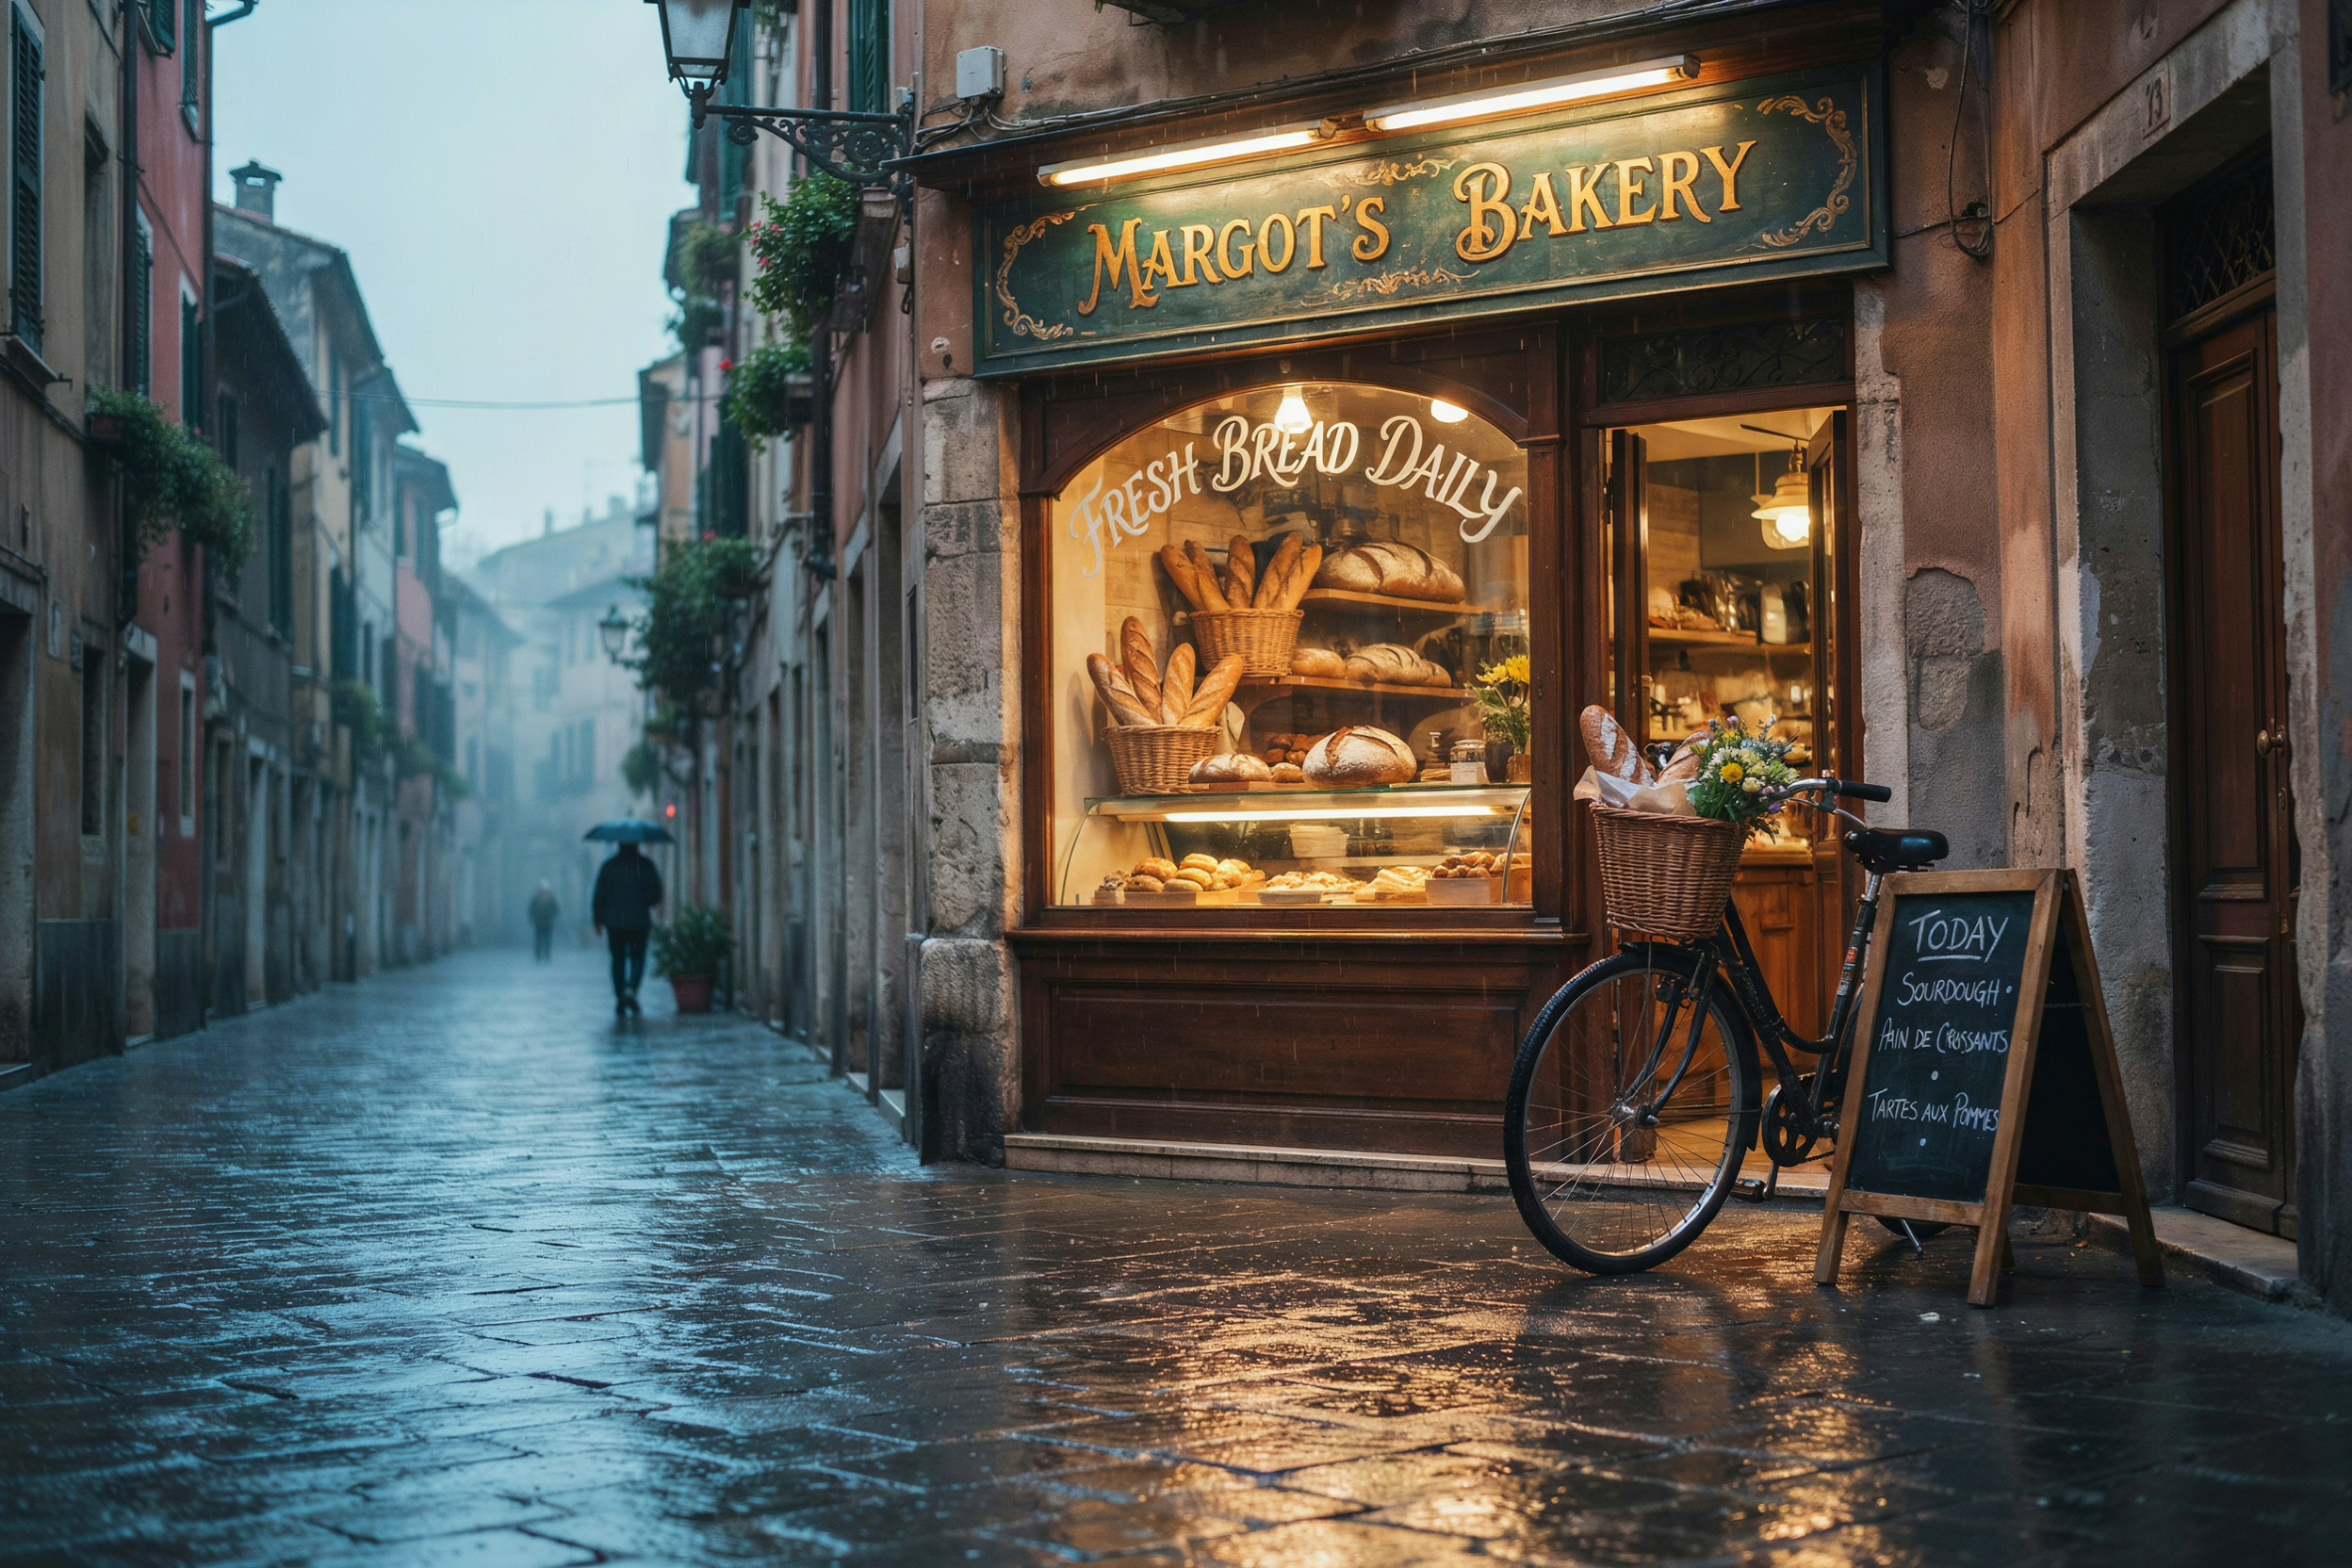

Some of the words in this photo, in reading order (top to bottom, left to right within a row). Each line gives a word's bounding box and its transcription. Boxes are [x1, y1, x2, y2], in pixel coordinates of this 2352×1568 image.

[1076, 192, 1390, 318] MARGOT'S
[1452, 139, 1757, 263] BAKERY
[1069, 441, 1201, 580] FRESH
[1212, 416, 1359, 492] BREAD
[1364, 415, 1523, 544] DAILY
[1908, 909, 2009, 963] TODAY
[1896, 972, 2001, 1008] SOURDOUGH
[1913, 1029, 1933, 1050] DE
[1868, 1087, 1919, 1121] TARTES
[1920, 1102, 1949, 1123] AUX
[1952, 1091, 2000, 1131] POMMES
